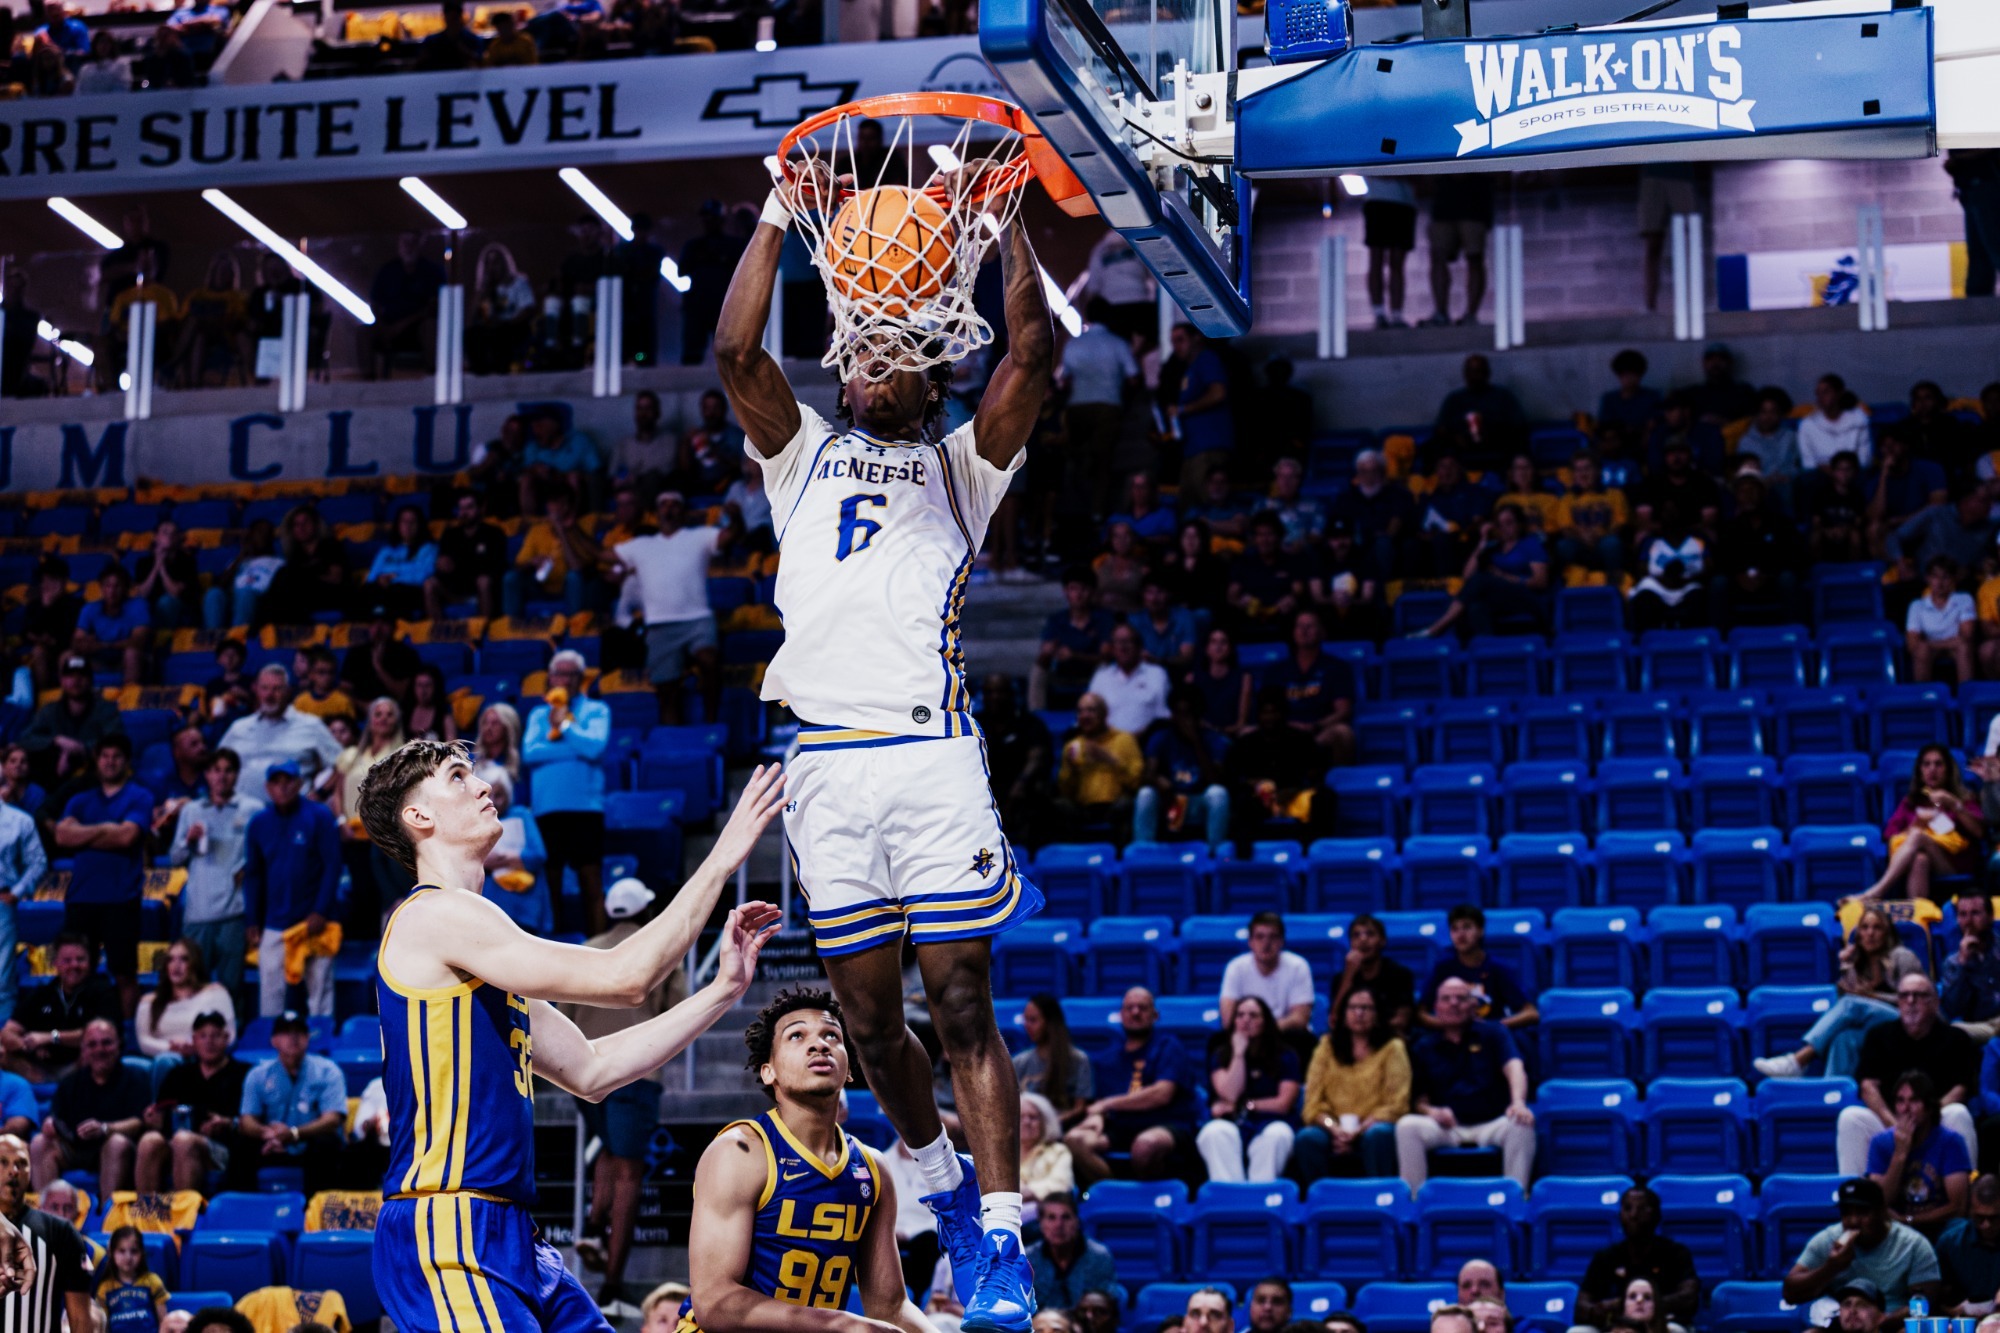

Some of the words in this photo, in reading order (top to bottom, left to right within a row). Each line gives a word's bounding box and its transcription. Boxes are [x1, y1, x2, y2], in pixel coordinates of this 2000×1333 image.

[0, 115, 118, 176] RE
[139, 99, 360, 168] SUITE
[384, 82, 643, 153] LEVEL
[1518, 107, 1586, 129] SPORTS
[1593, 102, 1691, 115] BISTREAUX
[0, 419, 130, 490] M
[834, 493, 889, 563] 6
[776, 1199, 871, 1242] LSU
[774, 1249, 851, 1311] 99
